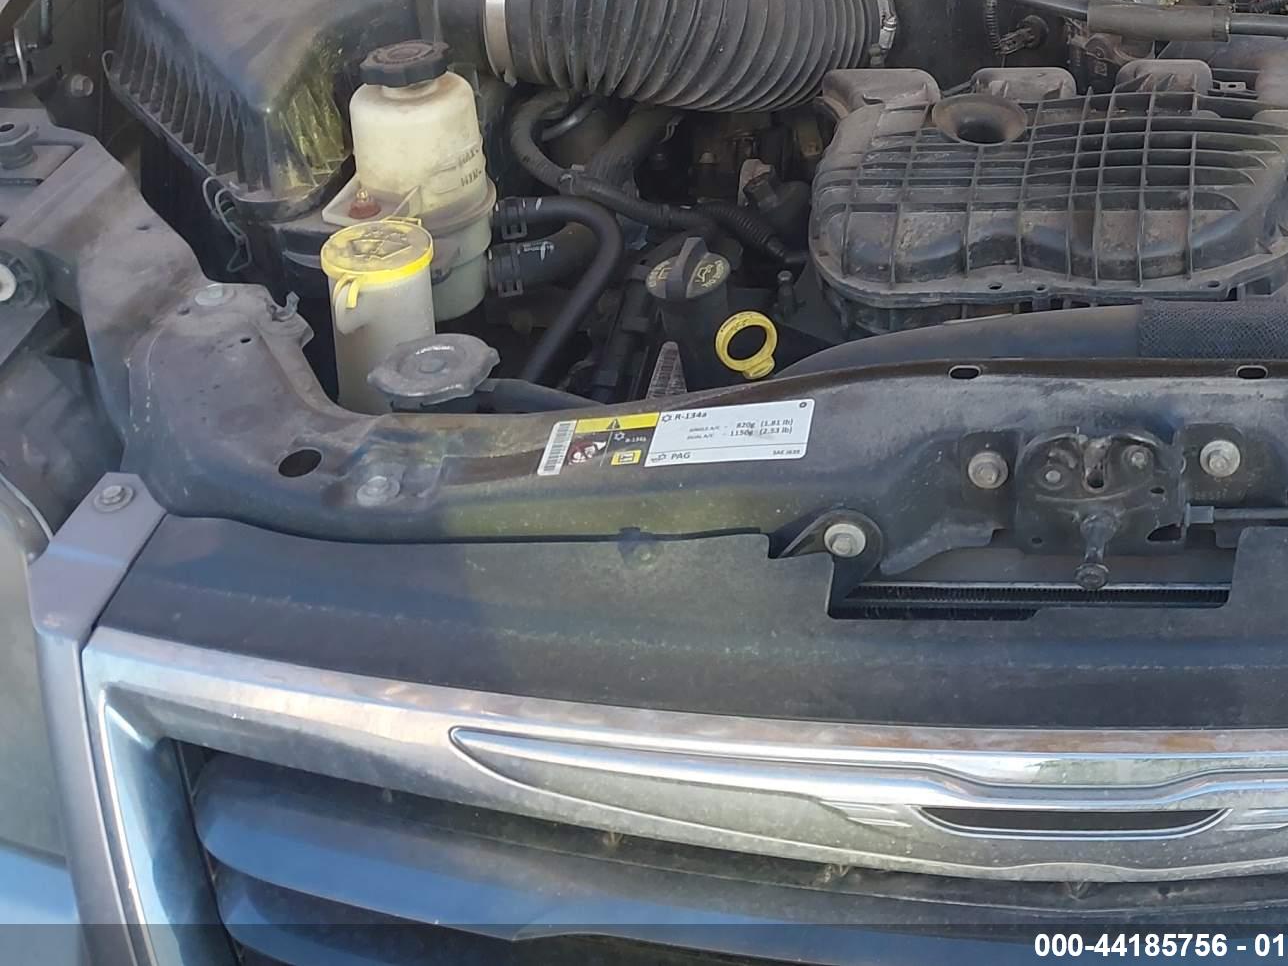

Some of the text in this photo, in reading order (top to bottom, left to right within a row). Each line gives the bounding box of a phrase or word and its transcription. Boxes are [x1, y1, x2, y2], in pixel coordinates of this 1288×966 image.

[674, 411, 708, 421] R-134a
[735, 422, 756, 430] 820g
[671, 452, 691, 460] PAG
